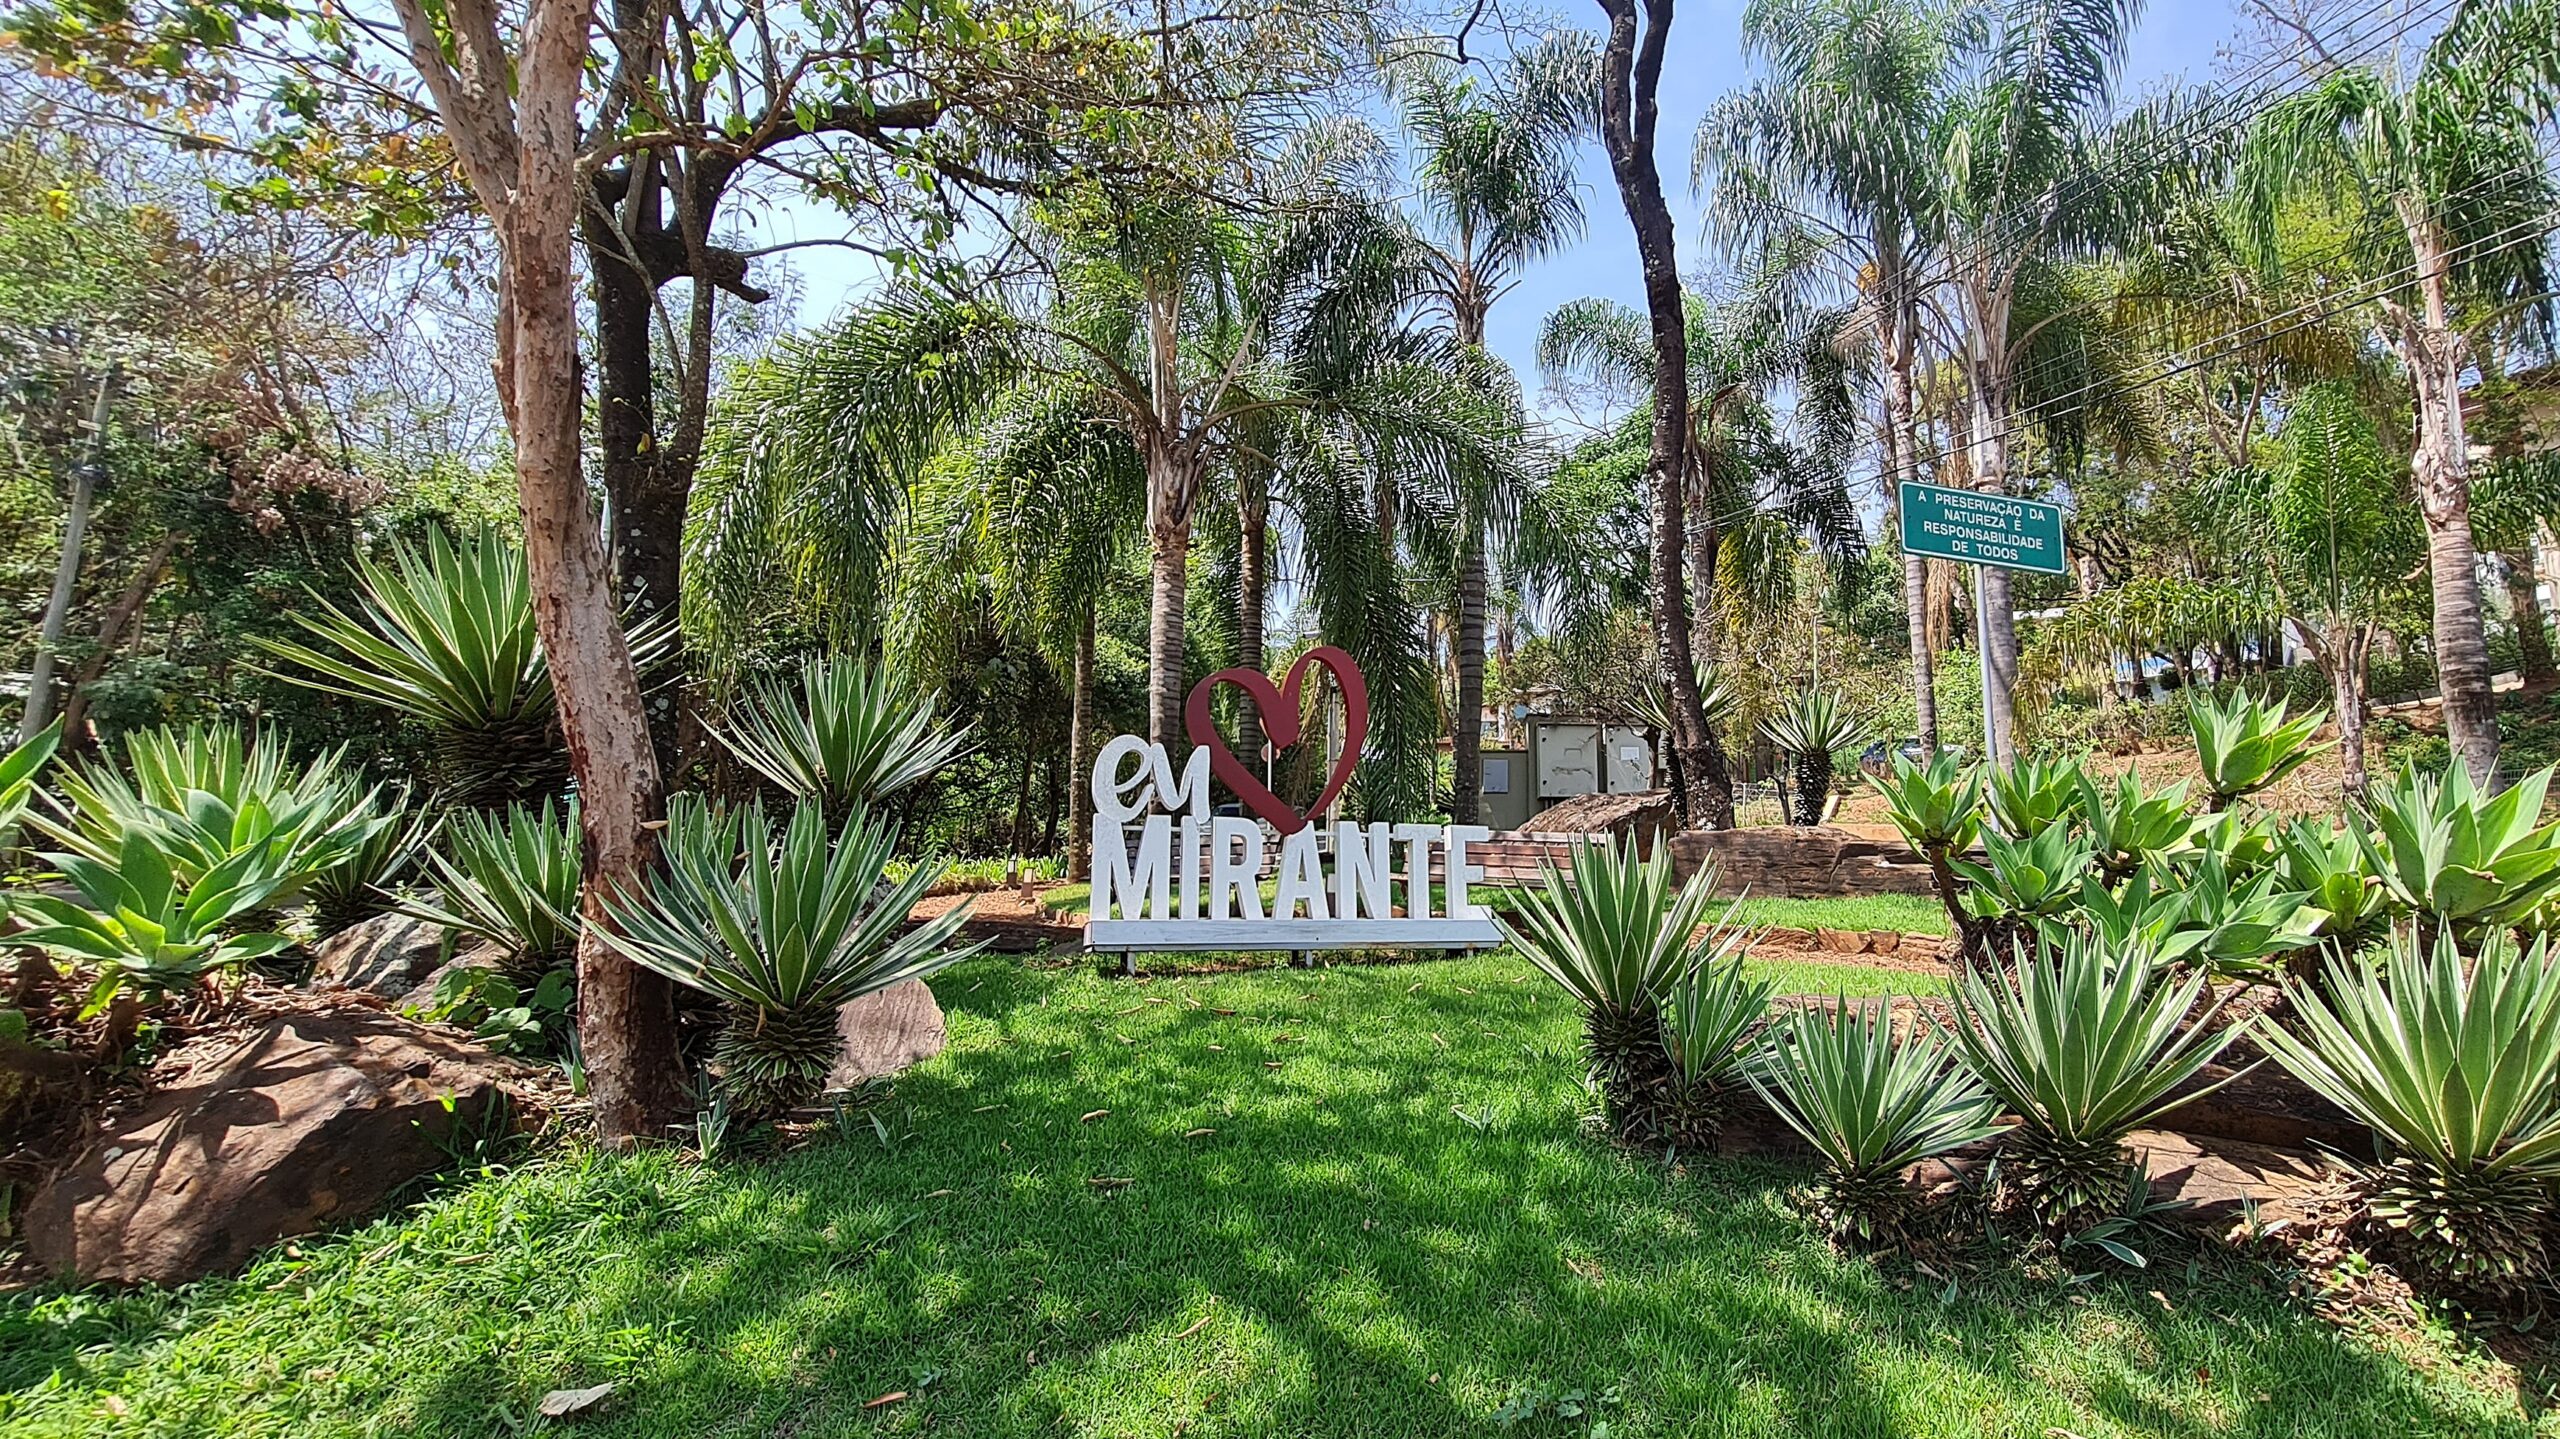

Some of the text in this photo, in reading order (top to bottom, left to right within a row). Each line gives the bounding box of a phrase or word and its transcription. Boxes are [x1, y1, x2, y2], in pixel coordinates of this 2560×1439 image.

[1918, 490, 2045, 522] A PRESERVAÇÃO DA
[1944, 509, 2022, 532] NATUREZA É
[1923, 520, 2043, 550] RESPONSABILIDADE
[1952, 540, 2018, 561] DE TODOS
[1089, 813, 1495, 921] MIRANTE
